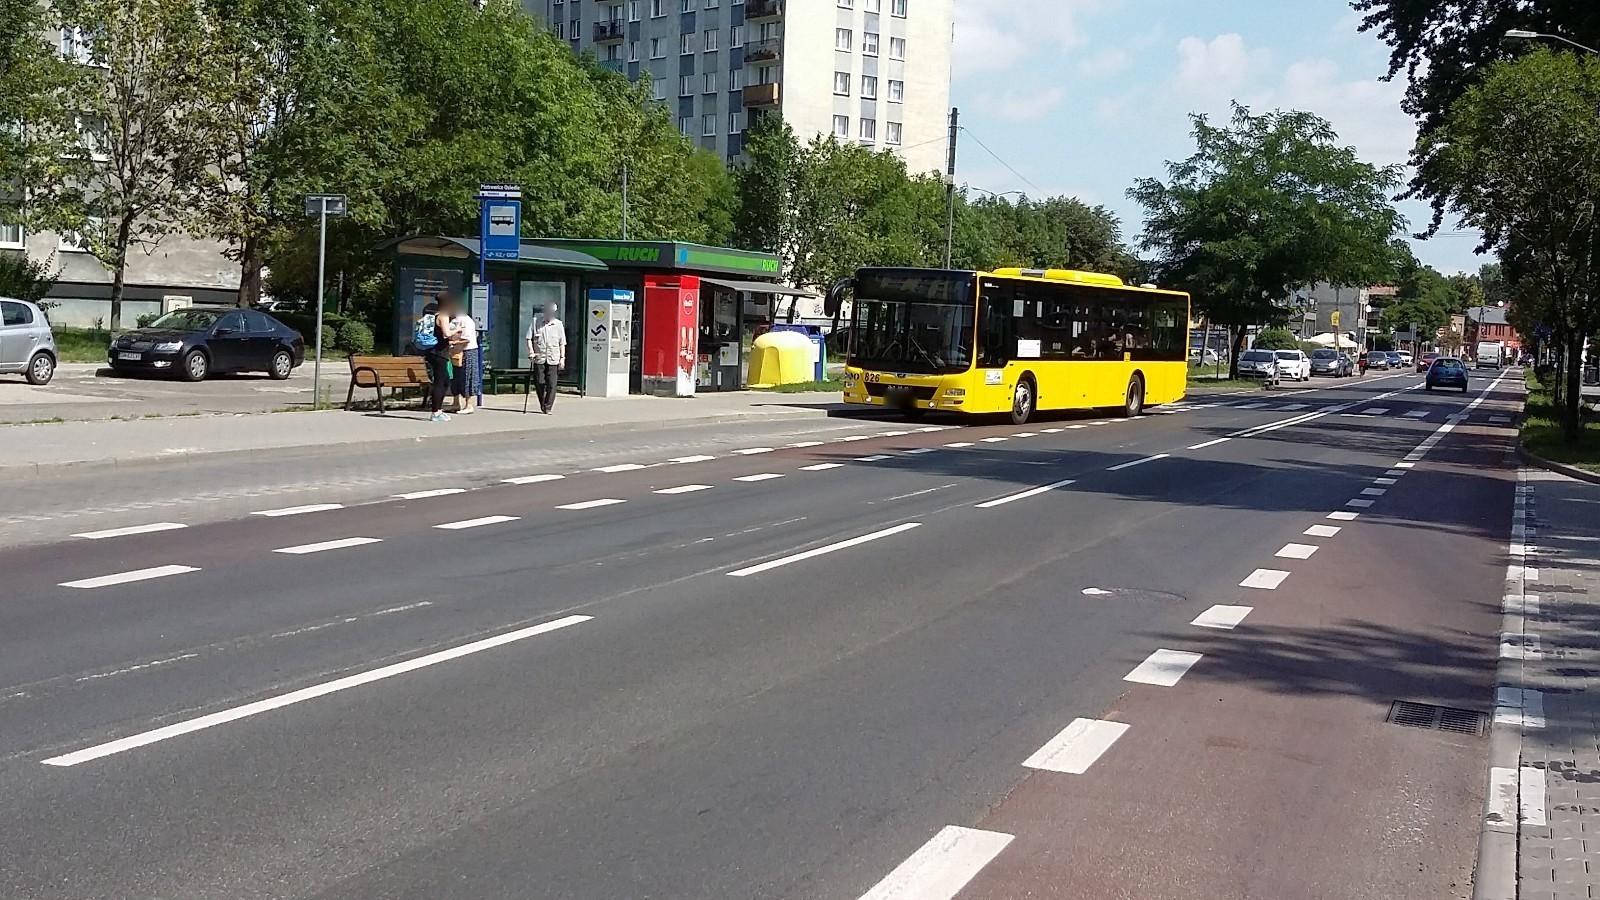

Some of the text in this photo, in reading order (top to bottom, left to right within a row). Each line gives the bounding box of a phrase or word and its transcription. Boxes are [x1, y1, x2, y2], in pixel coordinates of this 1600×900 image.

[618, 248, 659, 261] RUCH
[762, 259, 778, 272] RUCH
[864, 372, 880, 383] 826
